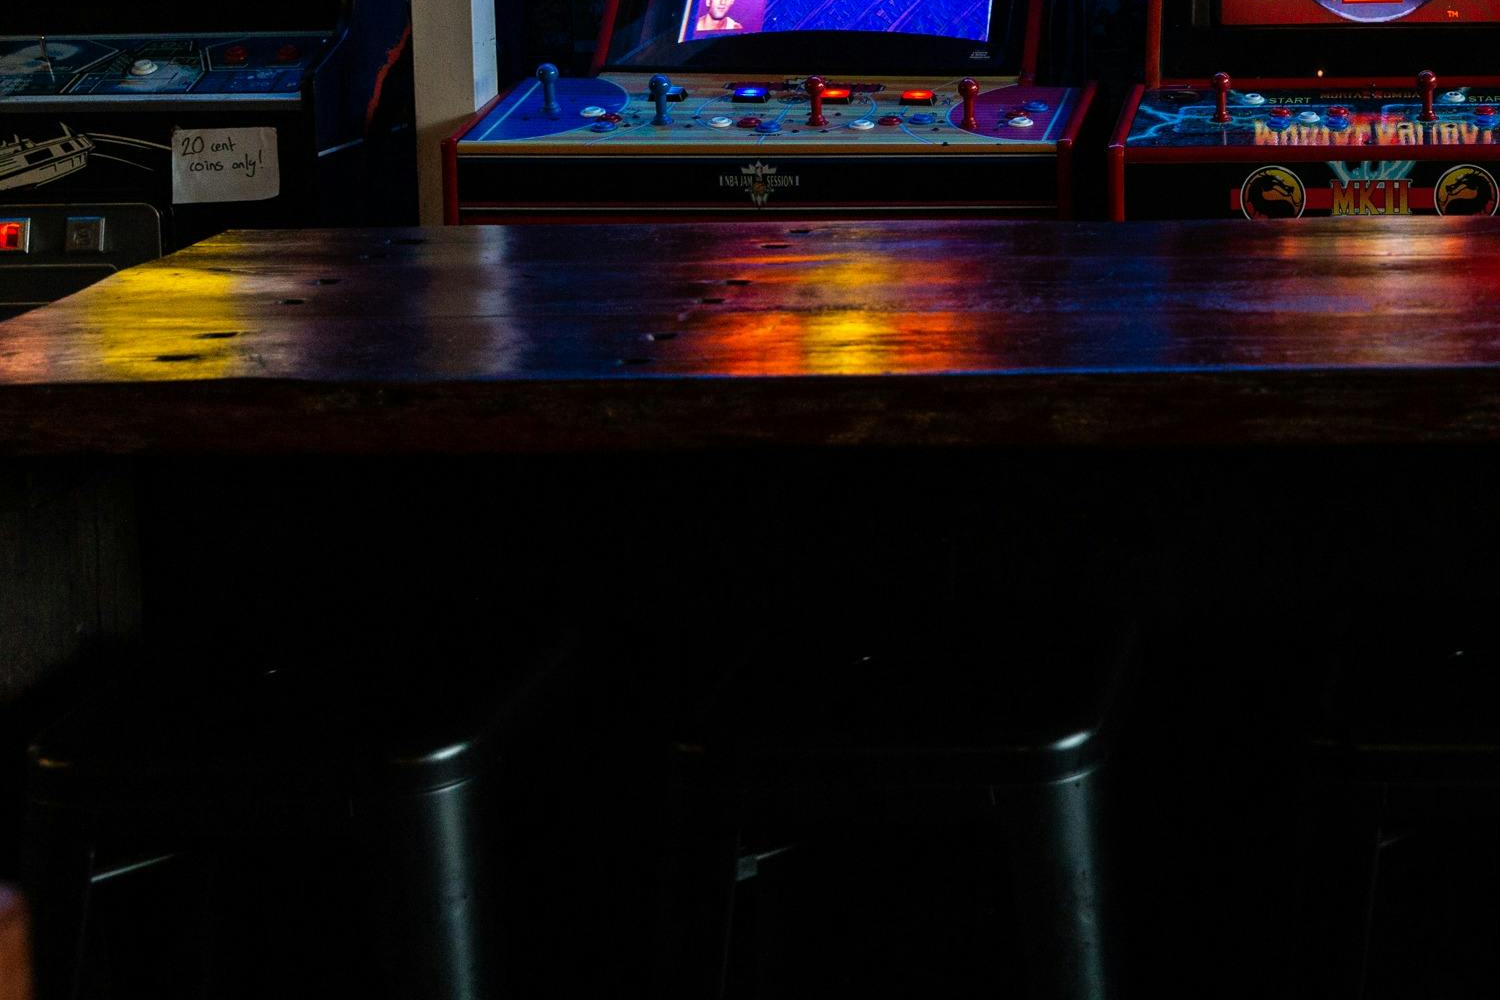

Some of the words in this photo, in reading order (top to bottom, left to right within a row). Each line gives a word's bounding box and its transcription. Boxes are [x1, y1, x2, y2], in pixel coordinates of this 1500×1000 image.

[1268, 97, 1312, 105] START
[180, 135, 205, 157] 20
[211, 139, 236, 153] cent
[189, 158, 224, 173] coins
[232, 152, 265, 178] only!
[766, 176, 793, 187] SESSION
[1330, 179, 1413, 216] MKII
